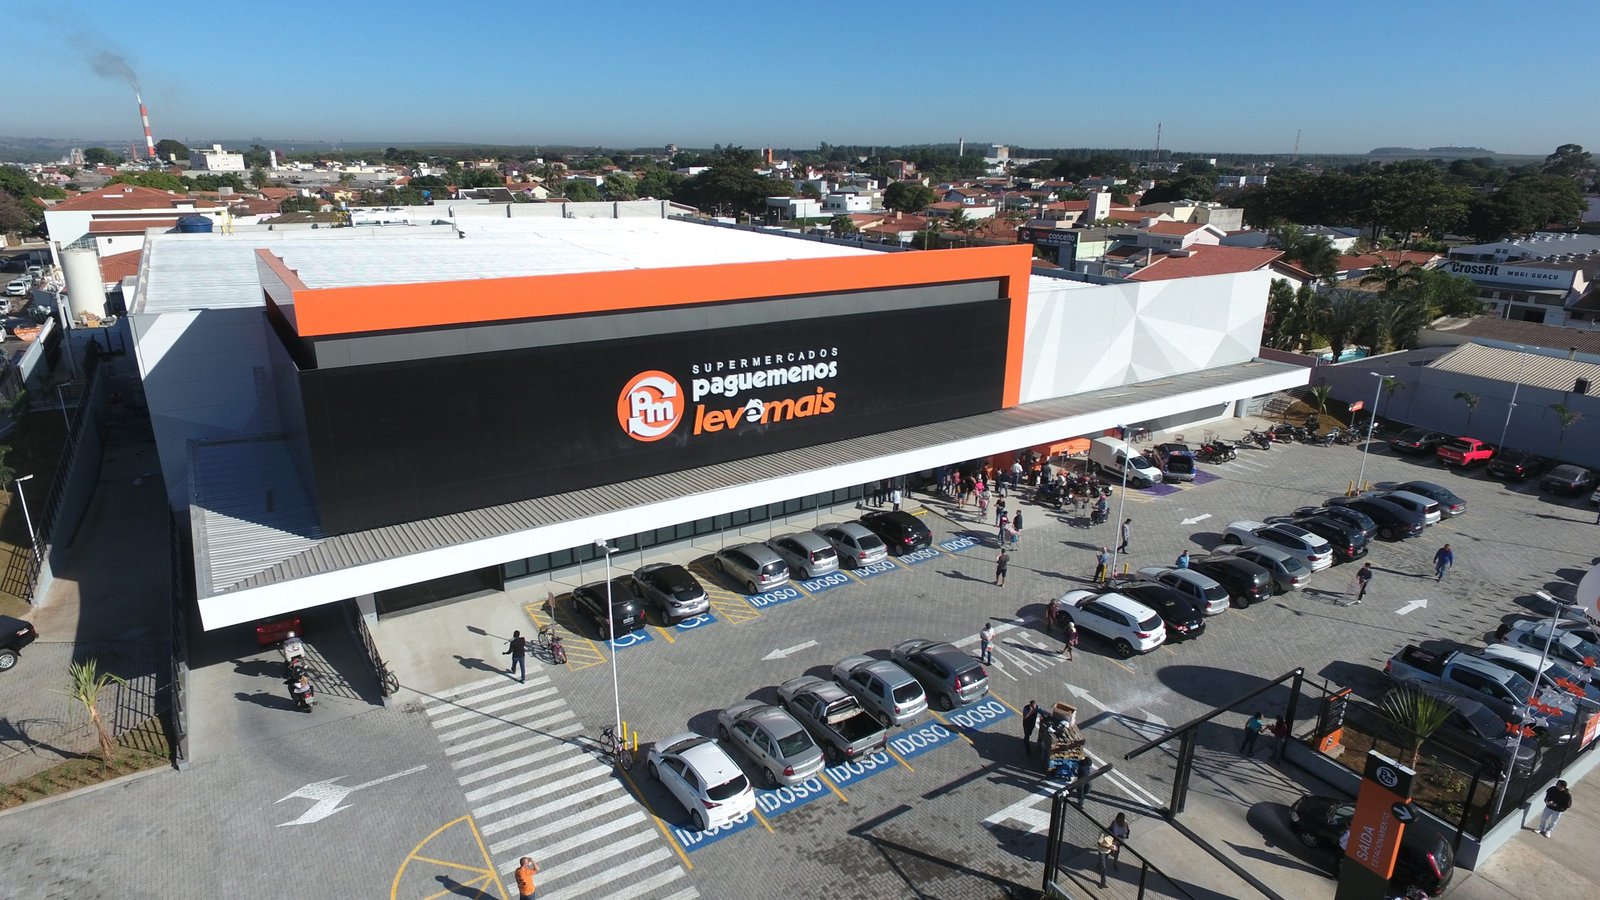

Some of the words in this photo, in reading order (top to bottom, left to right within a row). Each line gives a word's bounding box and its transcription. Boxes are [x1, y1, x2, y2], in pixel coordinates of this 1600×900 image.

[1452, 262, 1500, 276] CrossFit
[692, 347, 838, 375] SUPERMERCADOS
[692, 361, 838, 402] paguemenos
[851, 560, 896, 578] IDOSO
[898, 548, 940, 565] IDOSO
[802, 573, 849, 592] IDOSO
[750, 587, 798, 609] IDOSO
[950, 701, 1007, 730] IDOSO
[890, 724, 950, 756] IDOSO
[825, 750, 889, 784] IDOSO
[755, 777, 822, 812] IDOSO
[1356, 826, 1375, 861] SAÍDA
